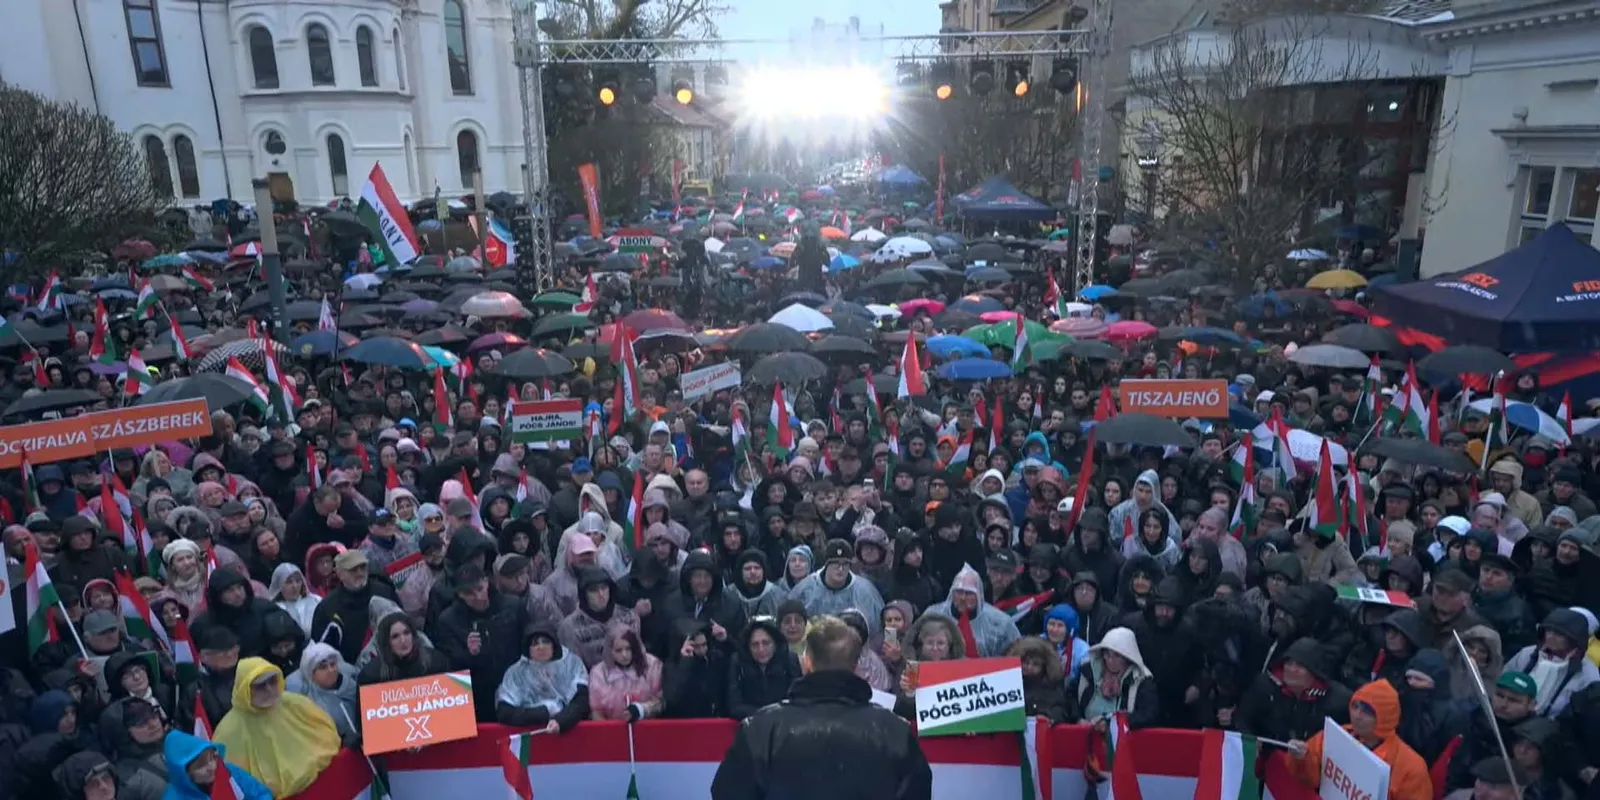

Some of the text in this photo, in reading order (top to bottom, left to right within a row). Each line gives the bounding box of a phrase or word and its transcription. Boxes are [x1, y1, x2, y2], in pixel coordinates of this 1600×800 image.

[620, 236, 652, 246] ABONY
[1128, 388, 1220, 406] TISZAJENŐ
[91, 411, 204, 440] SZÁSZBEREK
[519, 420, 577, 430] PÓCS JÁNOS!
[530, 413, 563, 422] HAJRÁ,
[381, 679, 448, 703] HAJRÁ,
[936, 677, 994, 703] HAJRÁ,
[366, 694, 469, 721] PÓCS JÁNOS!
[919, 688, 1022, 722] PÓCS JÁNOS!
